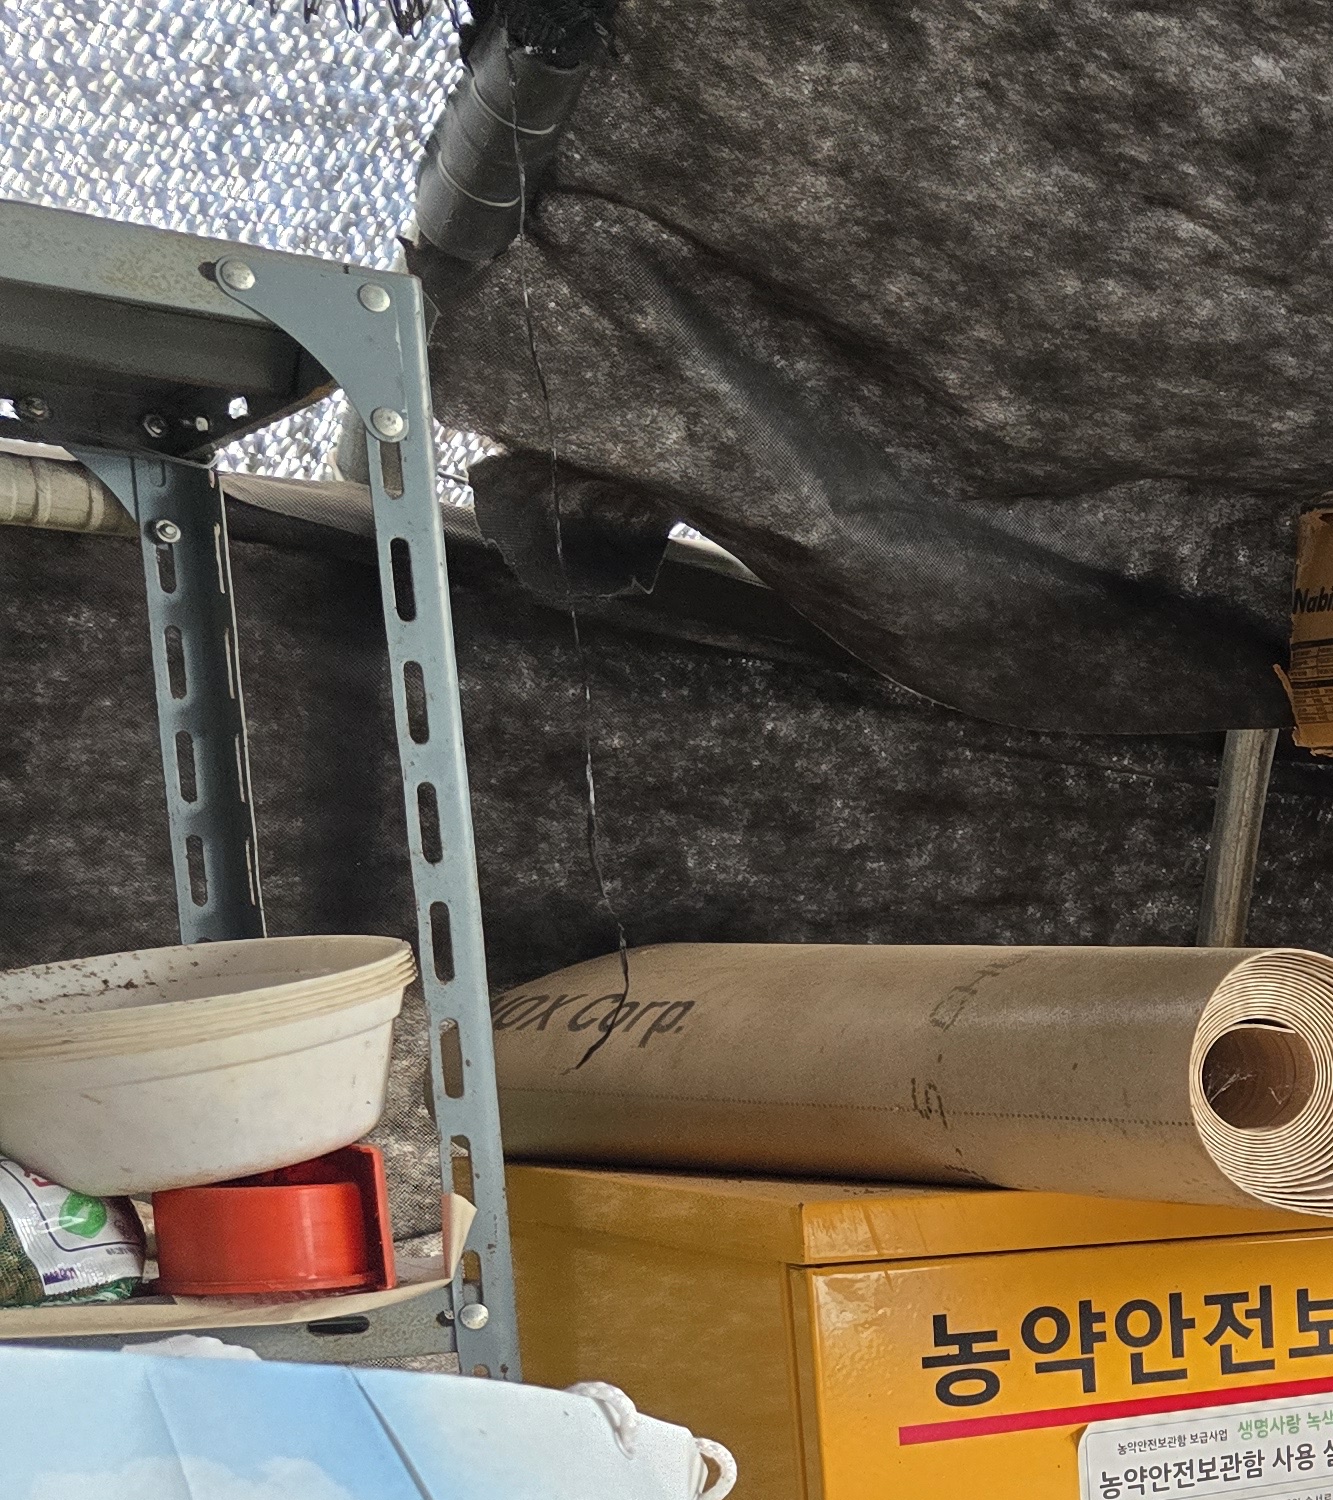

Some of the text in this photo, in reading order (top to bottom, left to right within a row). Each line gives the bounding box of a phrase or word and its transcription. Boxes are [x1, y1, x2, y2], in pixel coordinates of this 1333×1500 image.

[568, 994, 695, 1048] Corp.
[1117, 1434, 1187, 1456] 농약안전보관함
[1189, 1428, 1228, 1446] 보급사업
[1237, 1413, 1301, 1441] 생명사랑
[1100, 1449, 1265, 1500] 농약안전보관함
[1272, 1443, 1316, 1473] 사용
